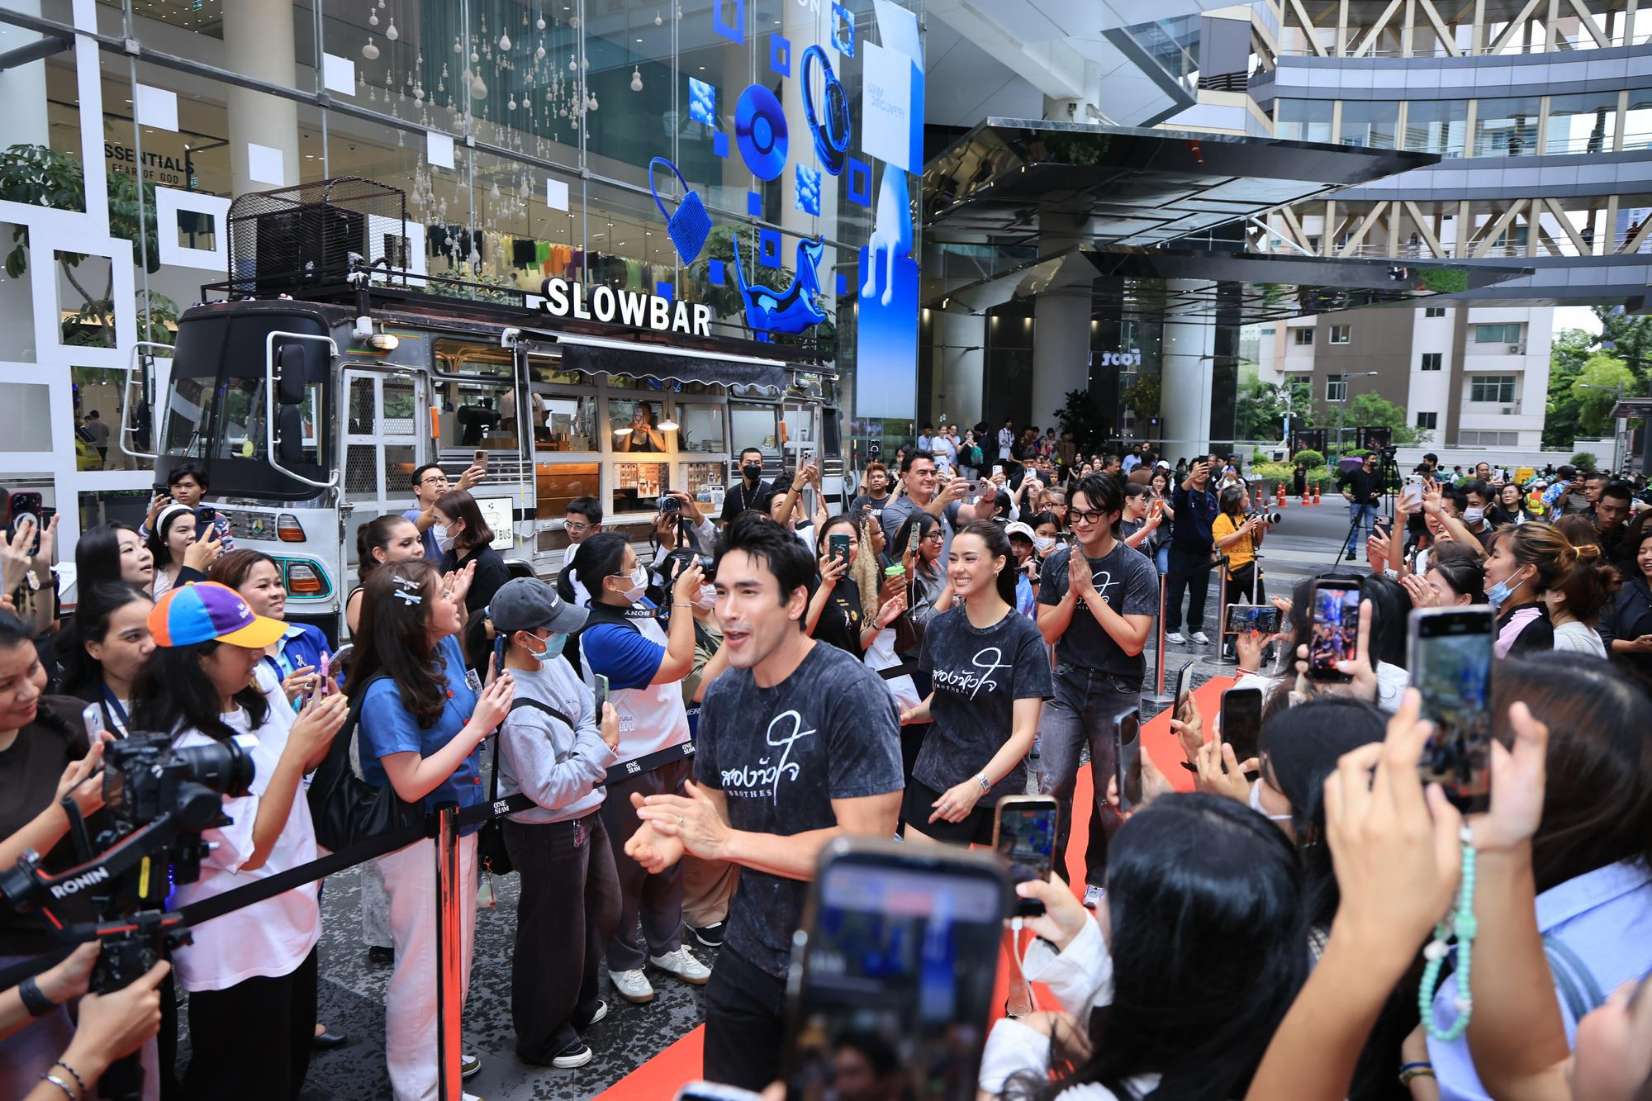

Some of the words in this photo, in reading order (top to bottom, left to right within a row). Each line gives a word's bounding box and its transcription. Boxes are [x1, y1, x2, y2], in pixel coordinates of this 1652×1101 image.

[104, 143, 194, 174] SSENTIALS
[143, 169, 154, 178] OF
[546, 278, 710, 336] SLOWBAR
[626, 760, 637, 768] ONE
[628, 765, 641, 773] SIAM
[493, 800, 506, 808] ONE
[494, 805, 510, 814] SIAM
[50, 866, 110, 899] RONIN
